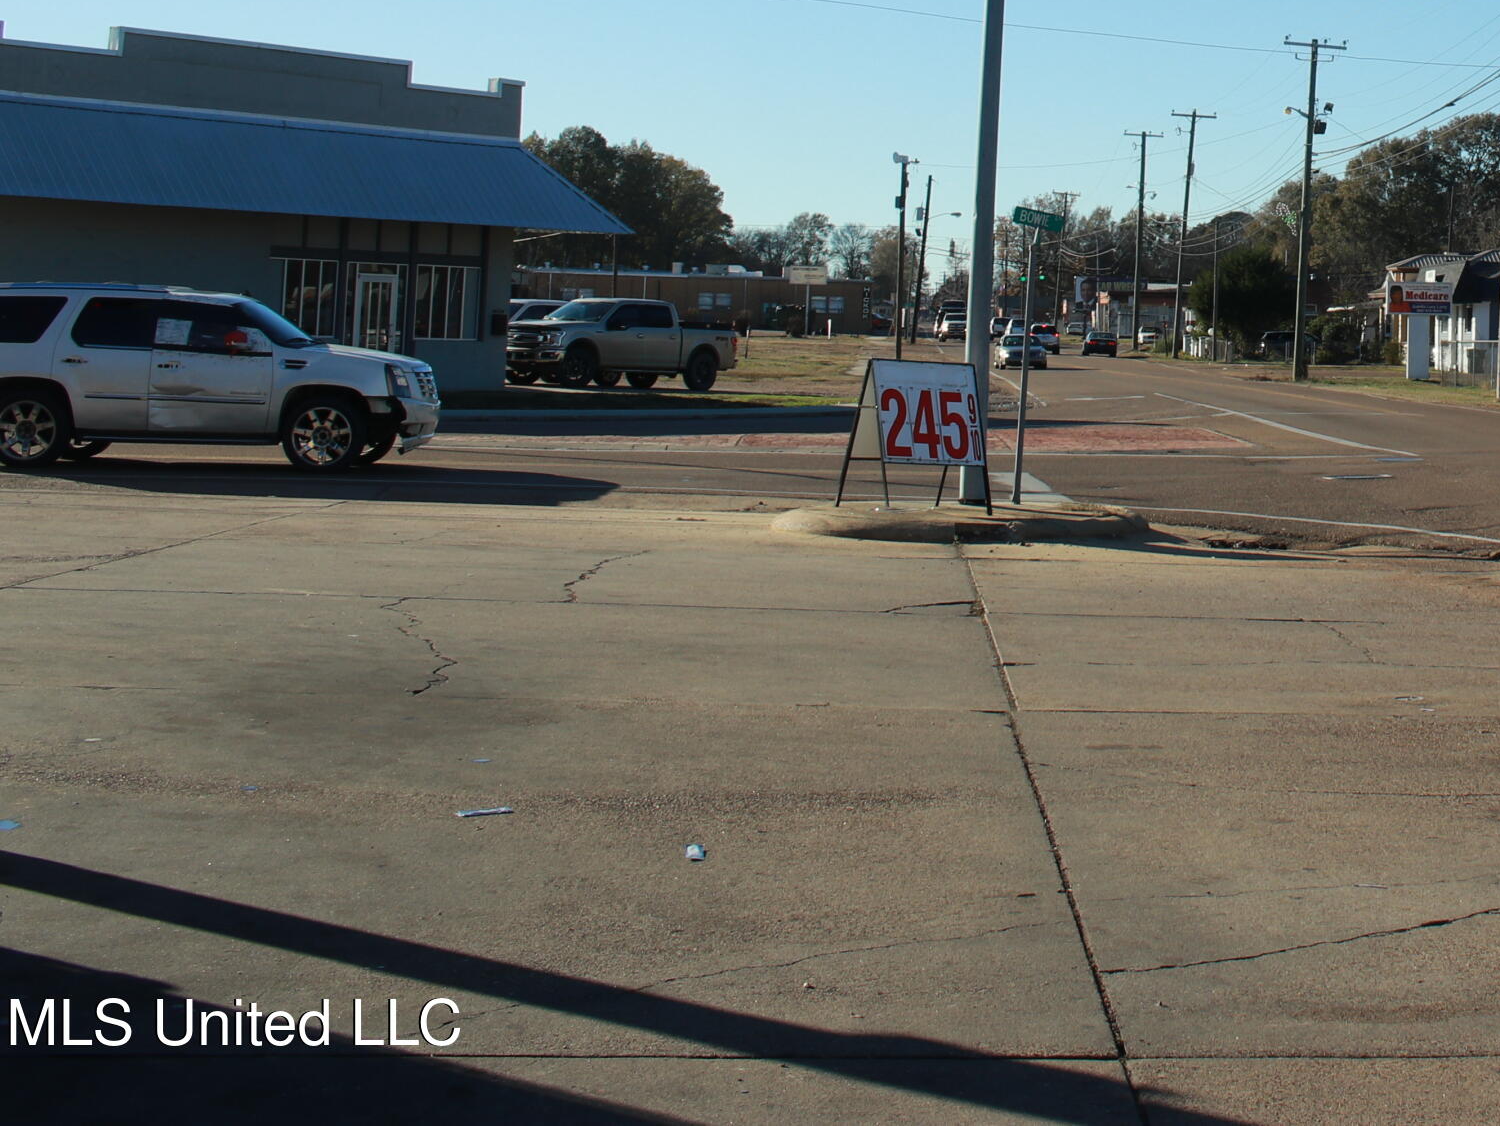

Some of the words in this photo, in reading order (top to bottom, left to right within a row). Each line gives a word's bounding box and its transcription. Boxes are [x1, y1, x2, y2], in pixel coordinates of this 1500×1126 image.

[1019, 210, 1049, 227] BOWIE
[1405, 290, 1449, 301] Medicare
[881, 388, 970, 460] 245
